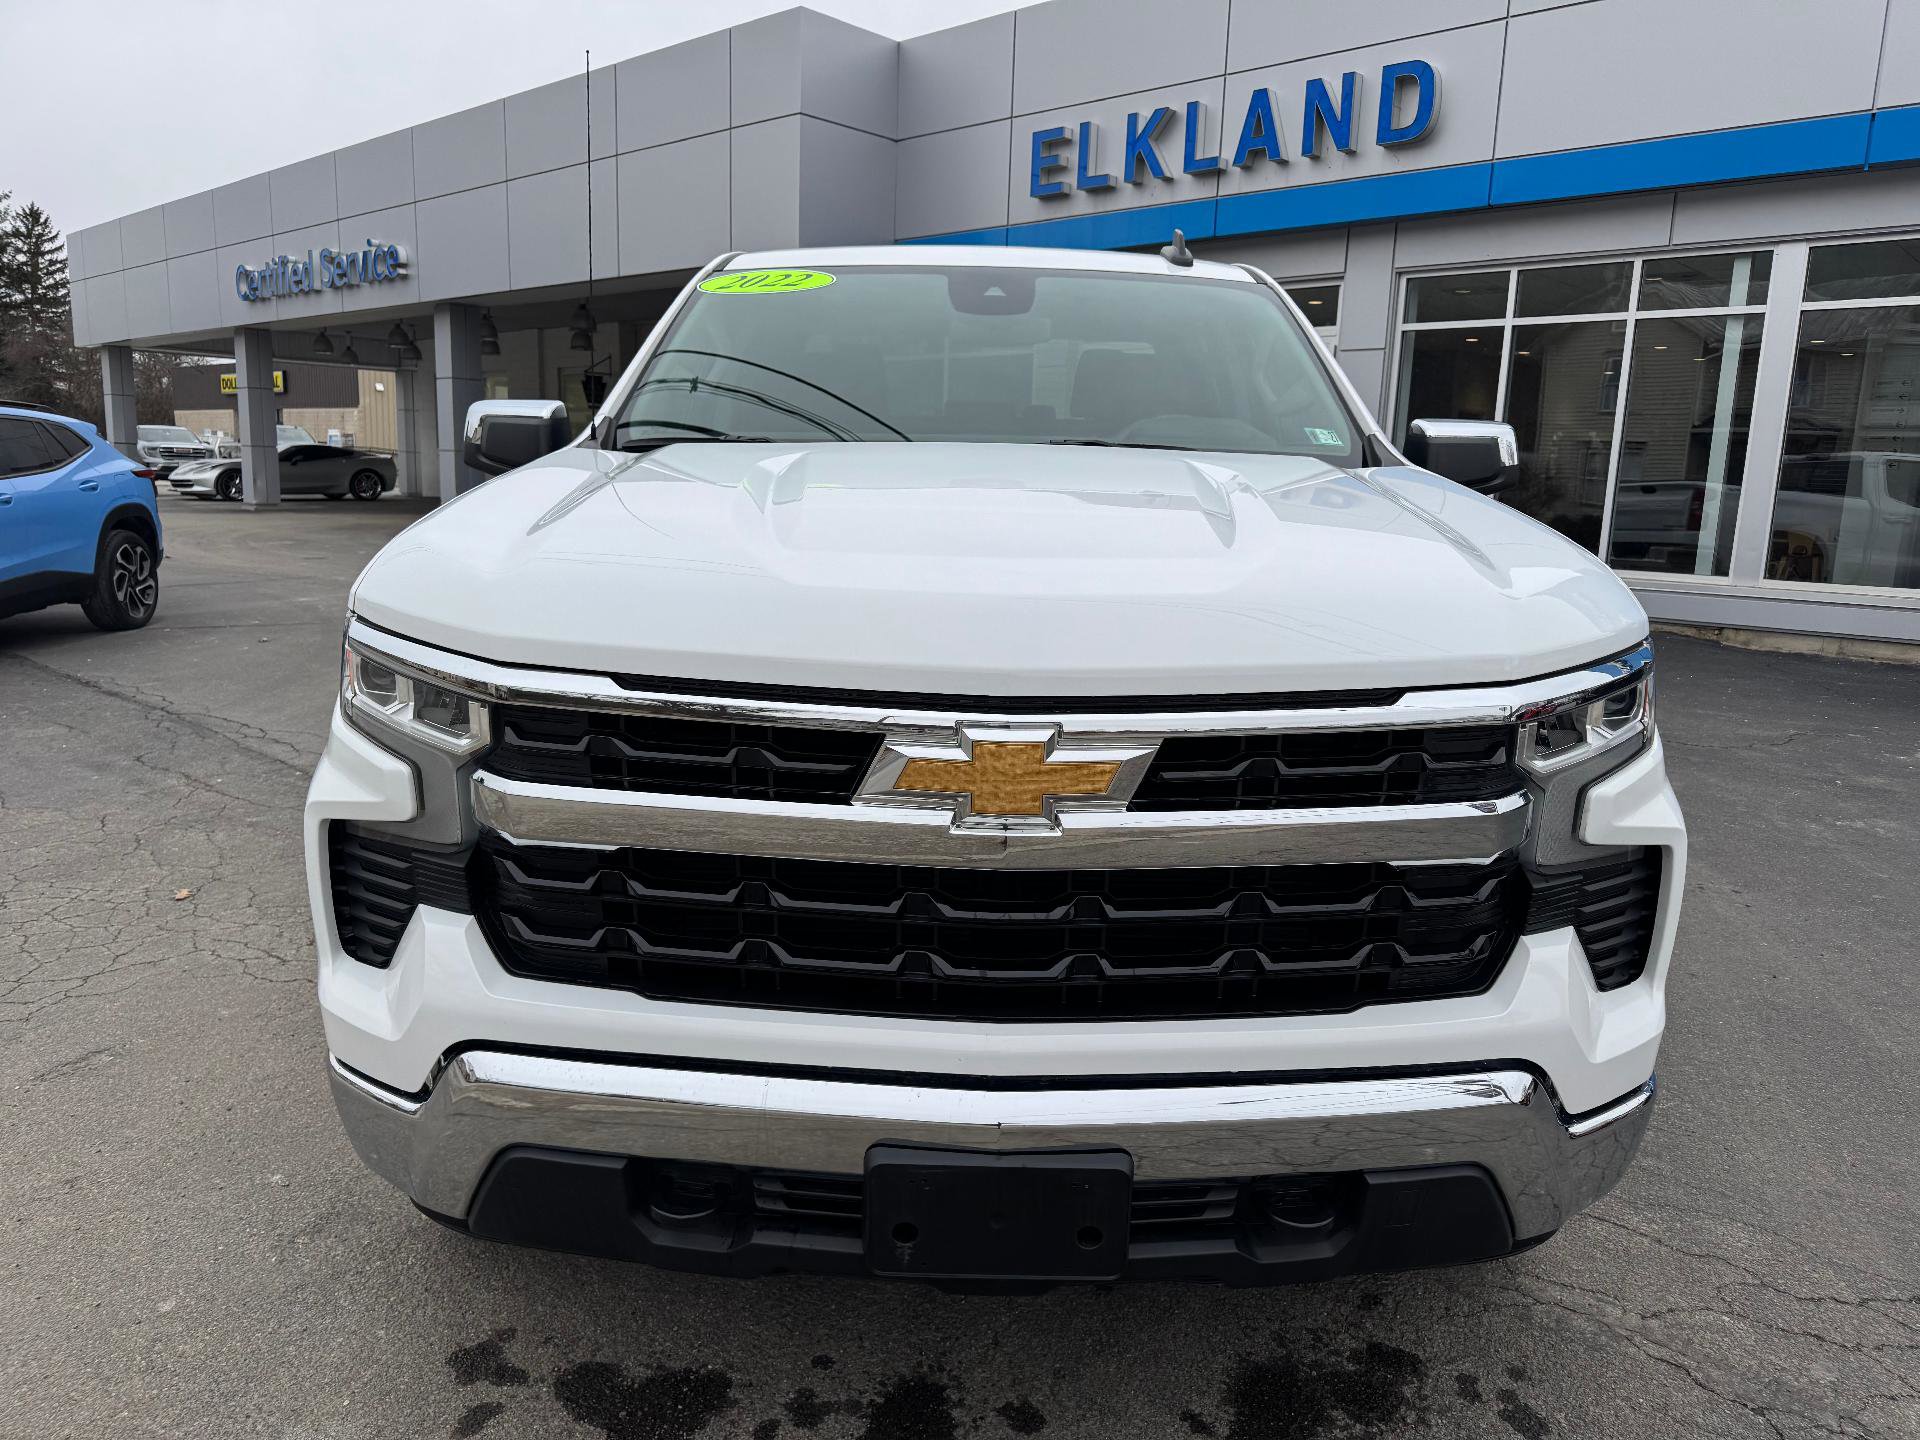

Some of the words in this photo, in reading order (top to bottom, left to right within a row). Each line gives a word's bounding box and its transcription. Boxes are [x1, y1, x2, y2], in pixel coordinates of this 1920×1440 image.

[1030, 59, 1442, 199] ELKLAND
[236, 250, 314, 301] Certified
[319, 238, 404, 288] Service
[713, 273, 814, 290] 2022
